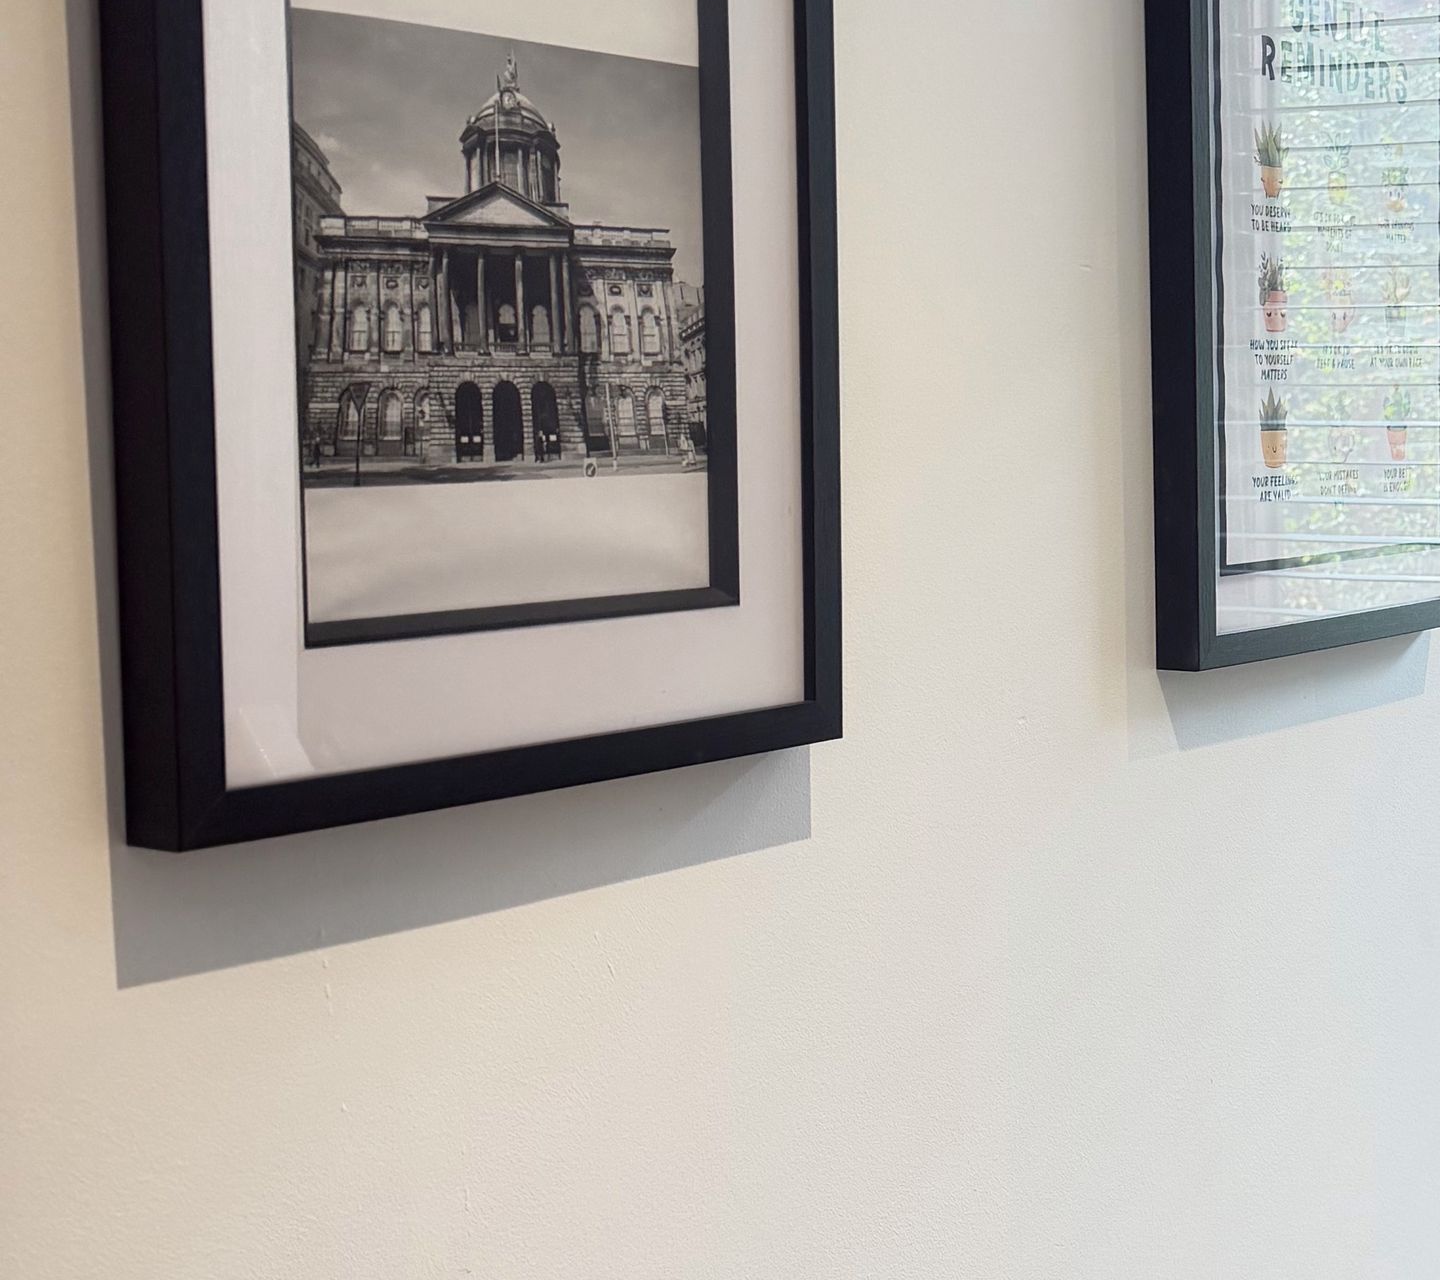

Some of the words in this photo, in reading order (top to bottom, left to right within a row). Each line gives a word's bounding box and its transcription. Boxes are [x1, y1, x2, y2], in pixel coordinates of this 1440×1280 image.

[1261, 35, 1408, 104] REMINDERS
[1250, 204, 1264, 216] YOU
[1251, 218, 1260, 230] TO
[1261, 220, 1269, 231] BE
[1250, 339, 1264, 350] HOW
[1266, 339, 1278, 350] YOU
[1255, 354, 1263, 365] TO
[1264, 354, 1293, 366] YOURSELF
[1261, 369, 1287, 380] MATTERS
[1252, 476, 1268, 488] YOUR
[1260, 490, 1272, 502] ARE
